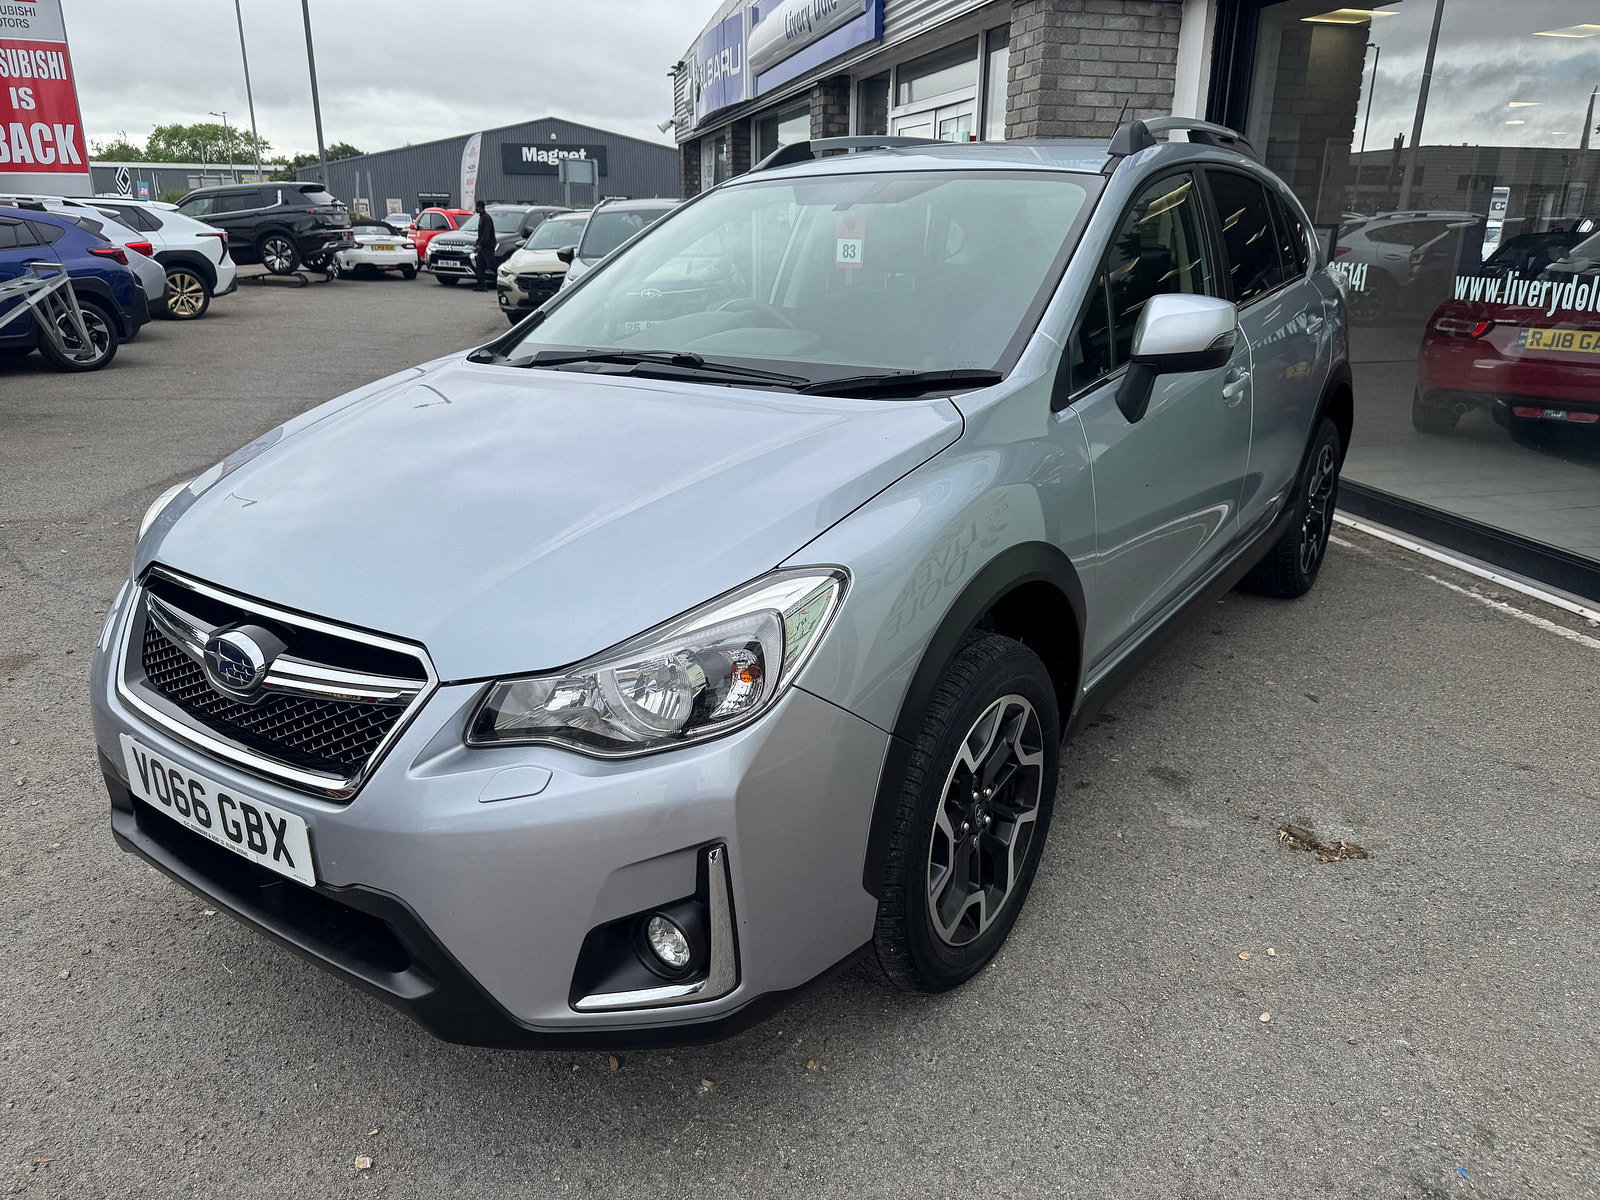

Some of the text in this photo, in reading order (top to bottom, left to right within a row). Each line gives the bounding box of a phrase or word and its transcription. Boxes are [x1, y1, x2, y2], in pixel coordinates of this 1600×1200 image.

[0, 5, 36, 17] UBISHI
[785, 4, 812, 40] Livery
[8, 87, 36, 110] IS
[521, 146, 587, 166] Magnet
[842, 243, 856, 259] 83
[1454, 270, 1600, 317] www.liverydol
[1529, 331, 1575, 349] RJ18
[131, 746, 296, 869] VO66 GBX
